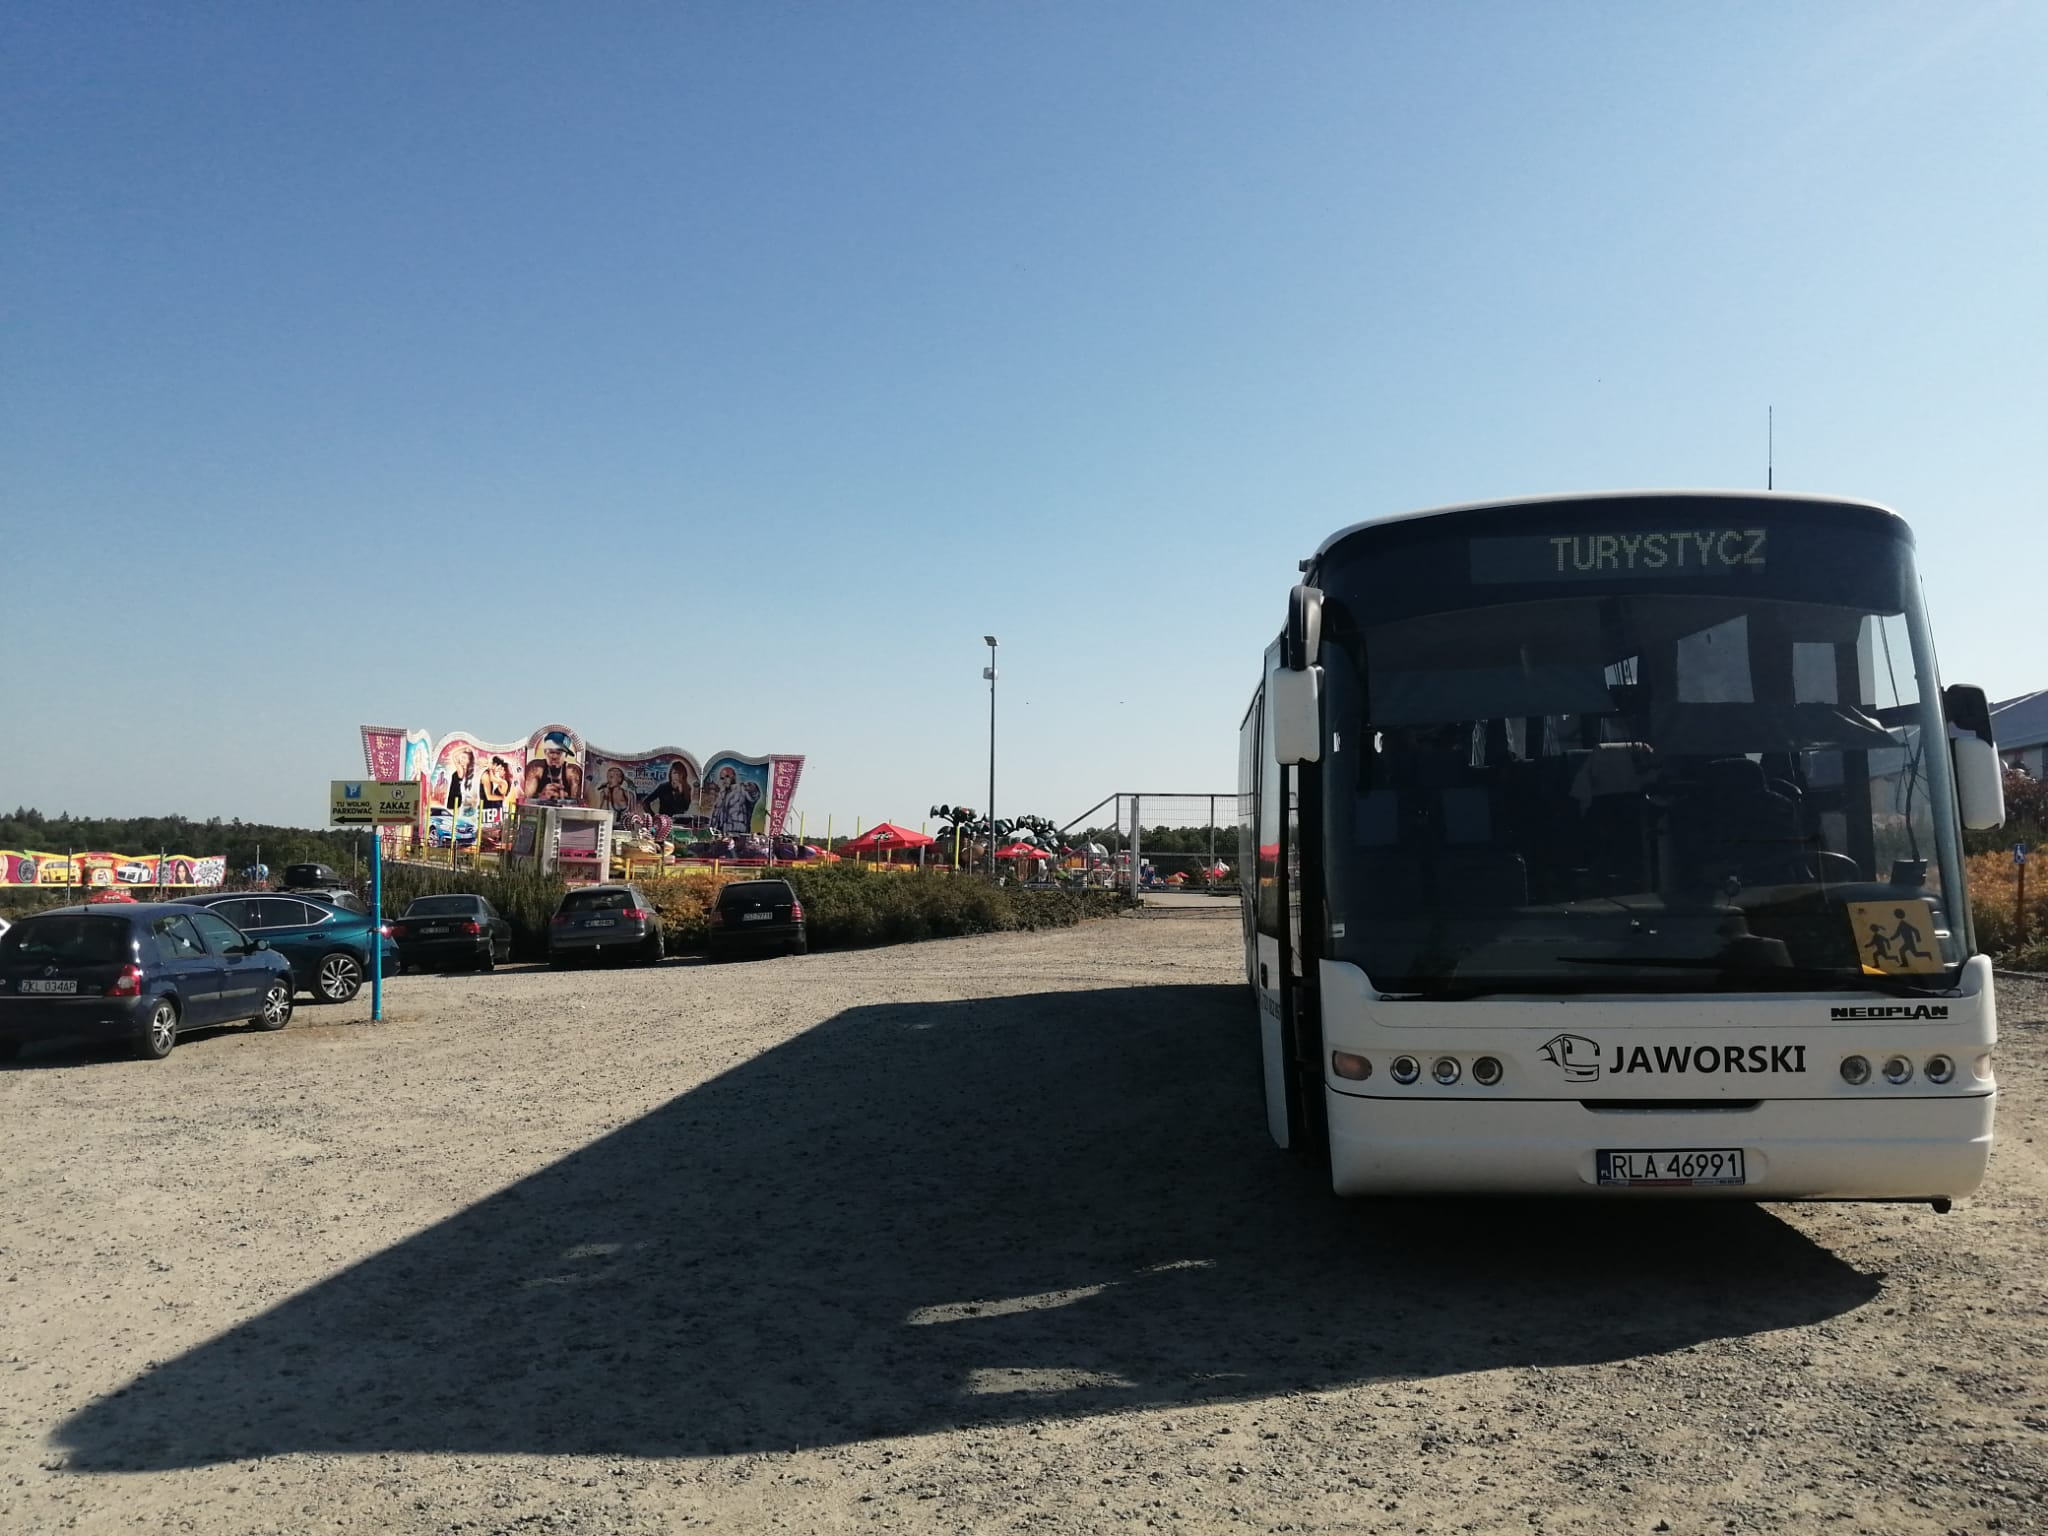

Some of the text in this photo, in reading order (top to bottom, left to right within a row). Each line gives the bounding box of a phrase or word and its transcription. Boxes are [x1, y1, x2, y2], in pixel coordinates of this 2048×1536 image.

[1550, 530, 1766, 571] TURYSTYCZ
[333, 807, 373, 815] PARKOWAĆ
[379, 801, 410, 810] ZAKAZ
[481, 808, 498, 823] TEP
[1831, 1005, 1948, 1020] NEOPLAN
[1609, 1045, 1807, 1073] JAWORSKI
[1612, 1153, 1738, 1178] RLA 46991
